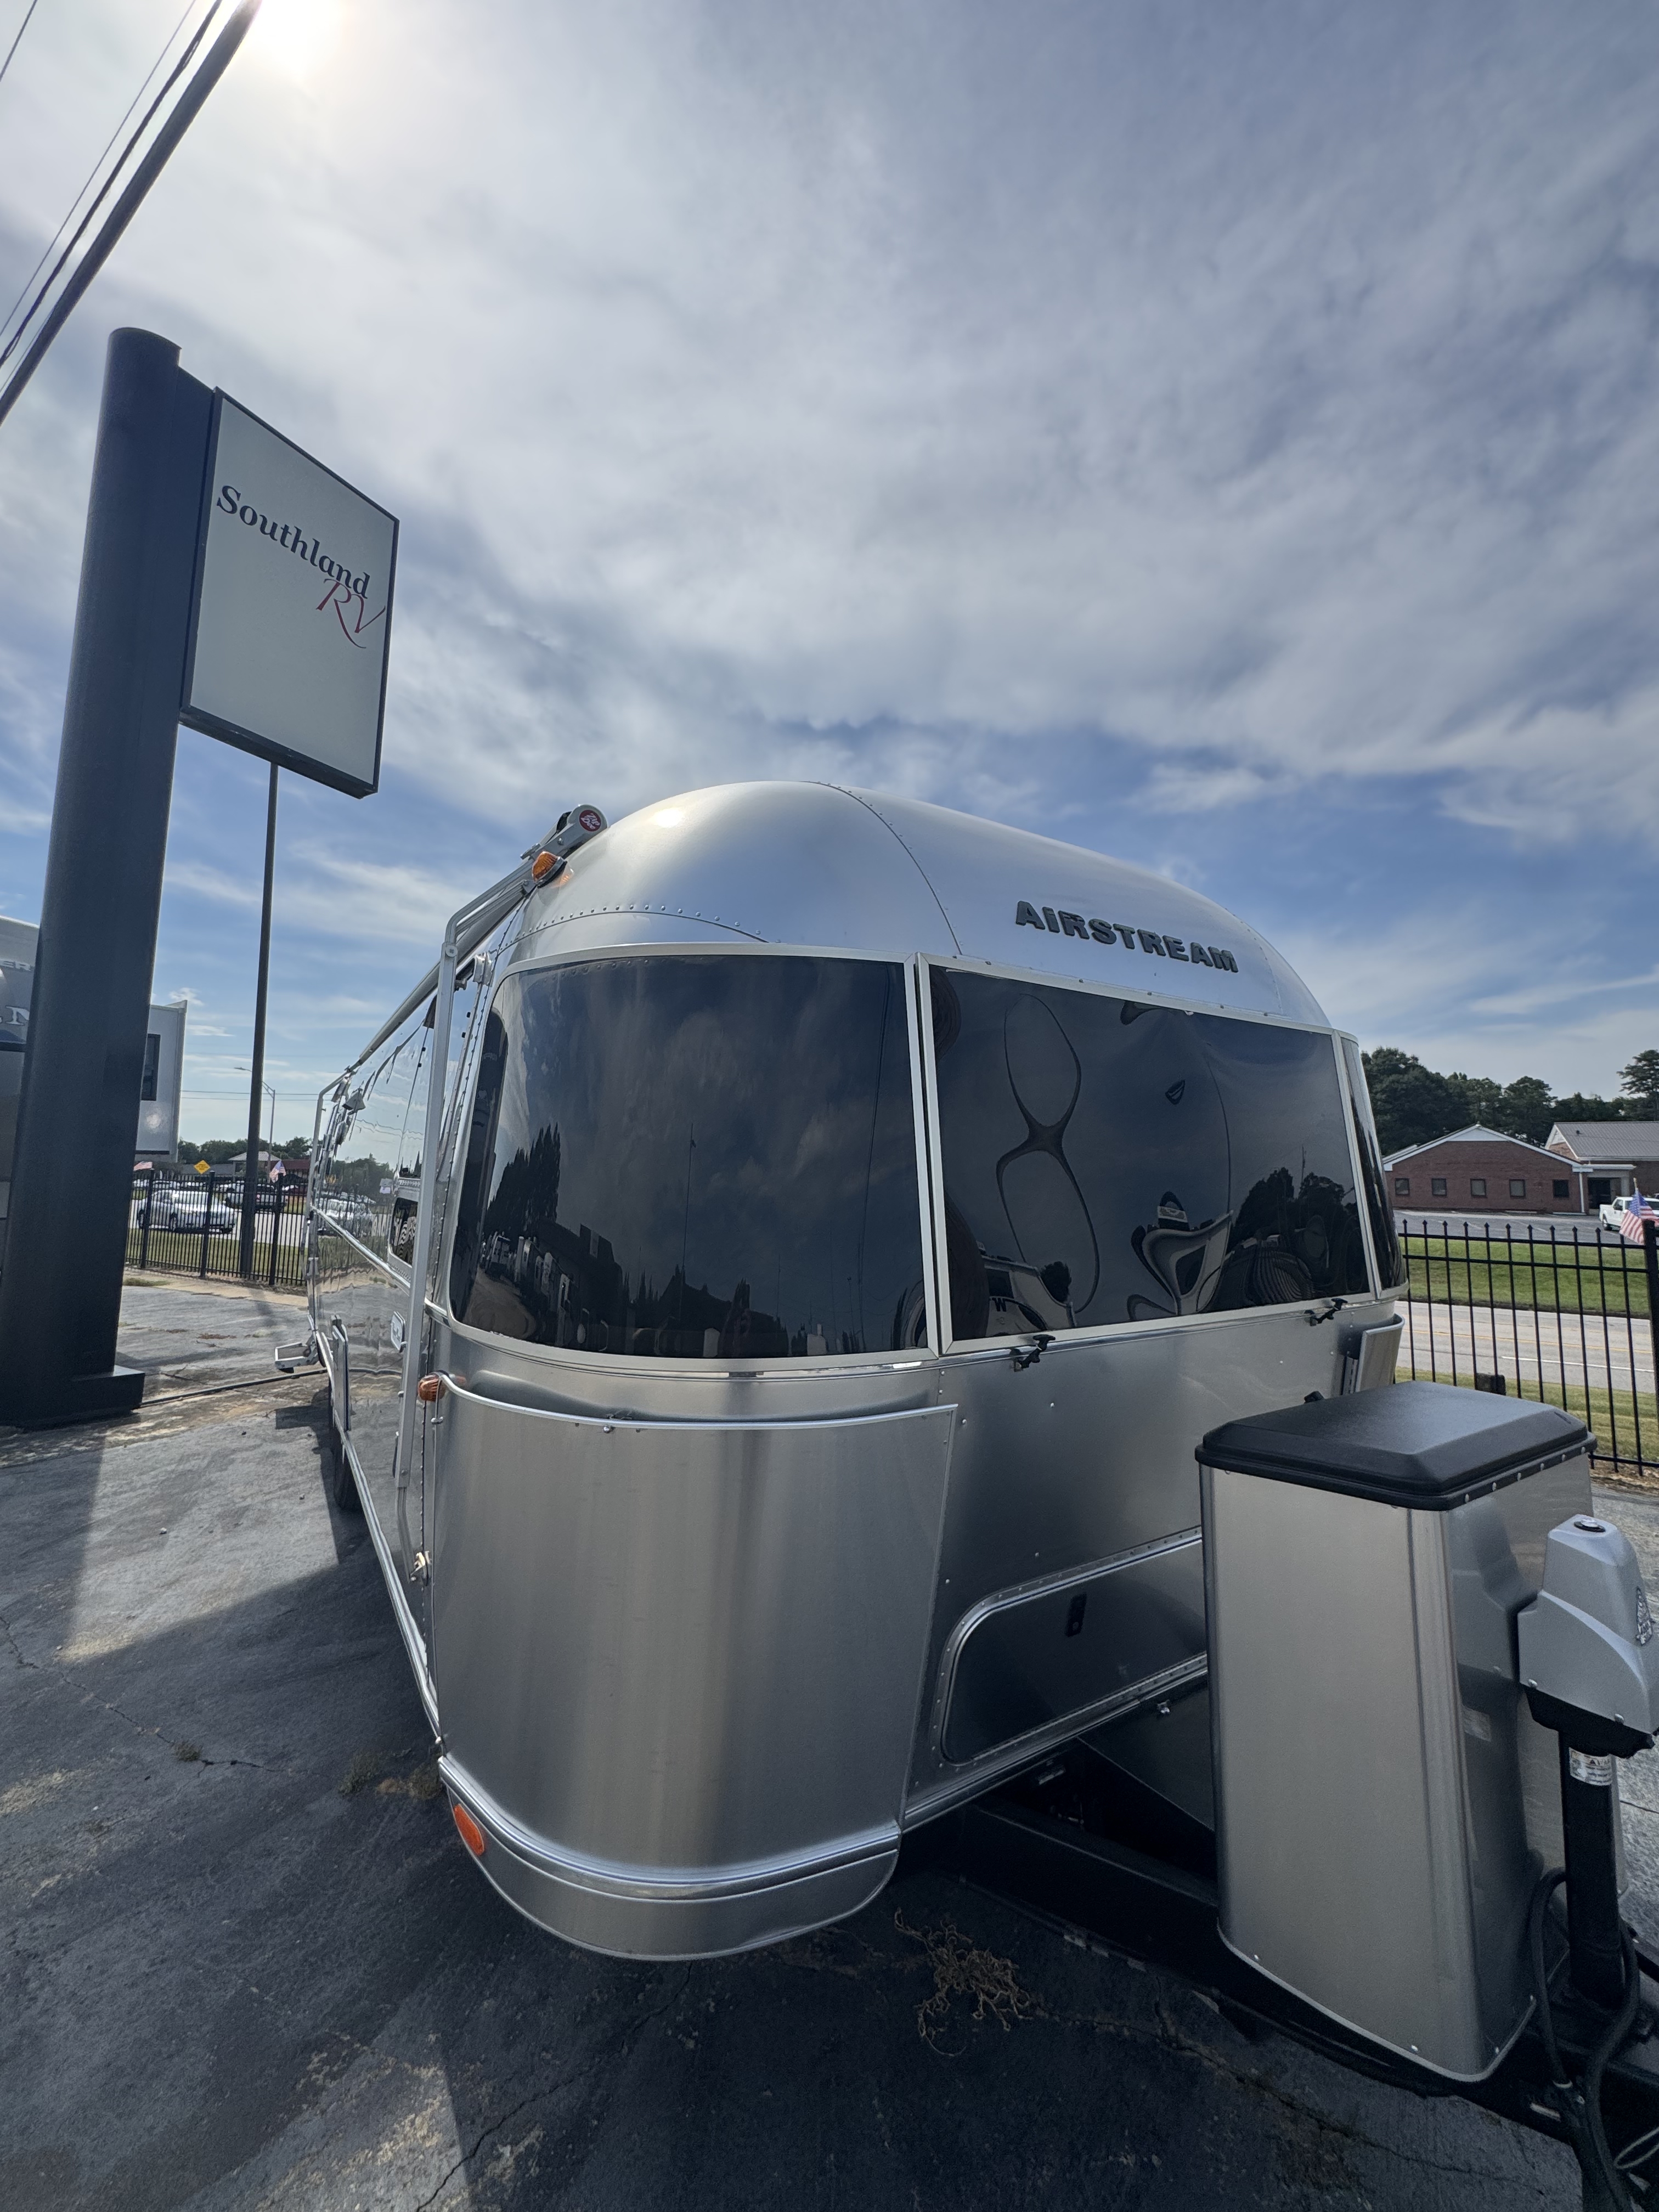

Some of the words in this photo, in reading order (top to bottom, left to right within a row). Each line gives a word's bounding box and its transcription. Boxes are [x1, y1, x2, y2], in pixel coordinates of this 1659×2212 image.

[216, 485, 370, 599] Southland
[316, 578, 386, 648] RV
[1015, 900, 1239, 973] AIRSTREAM
